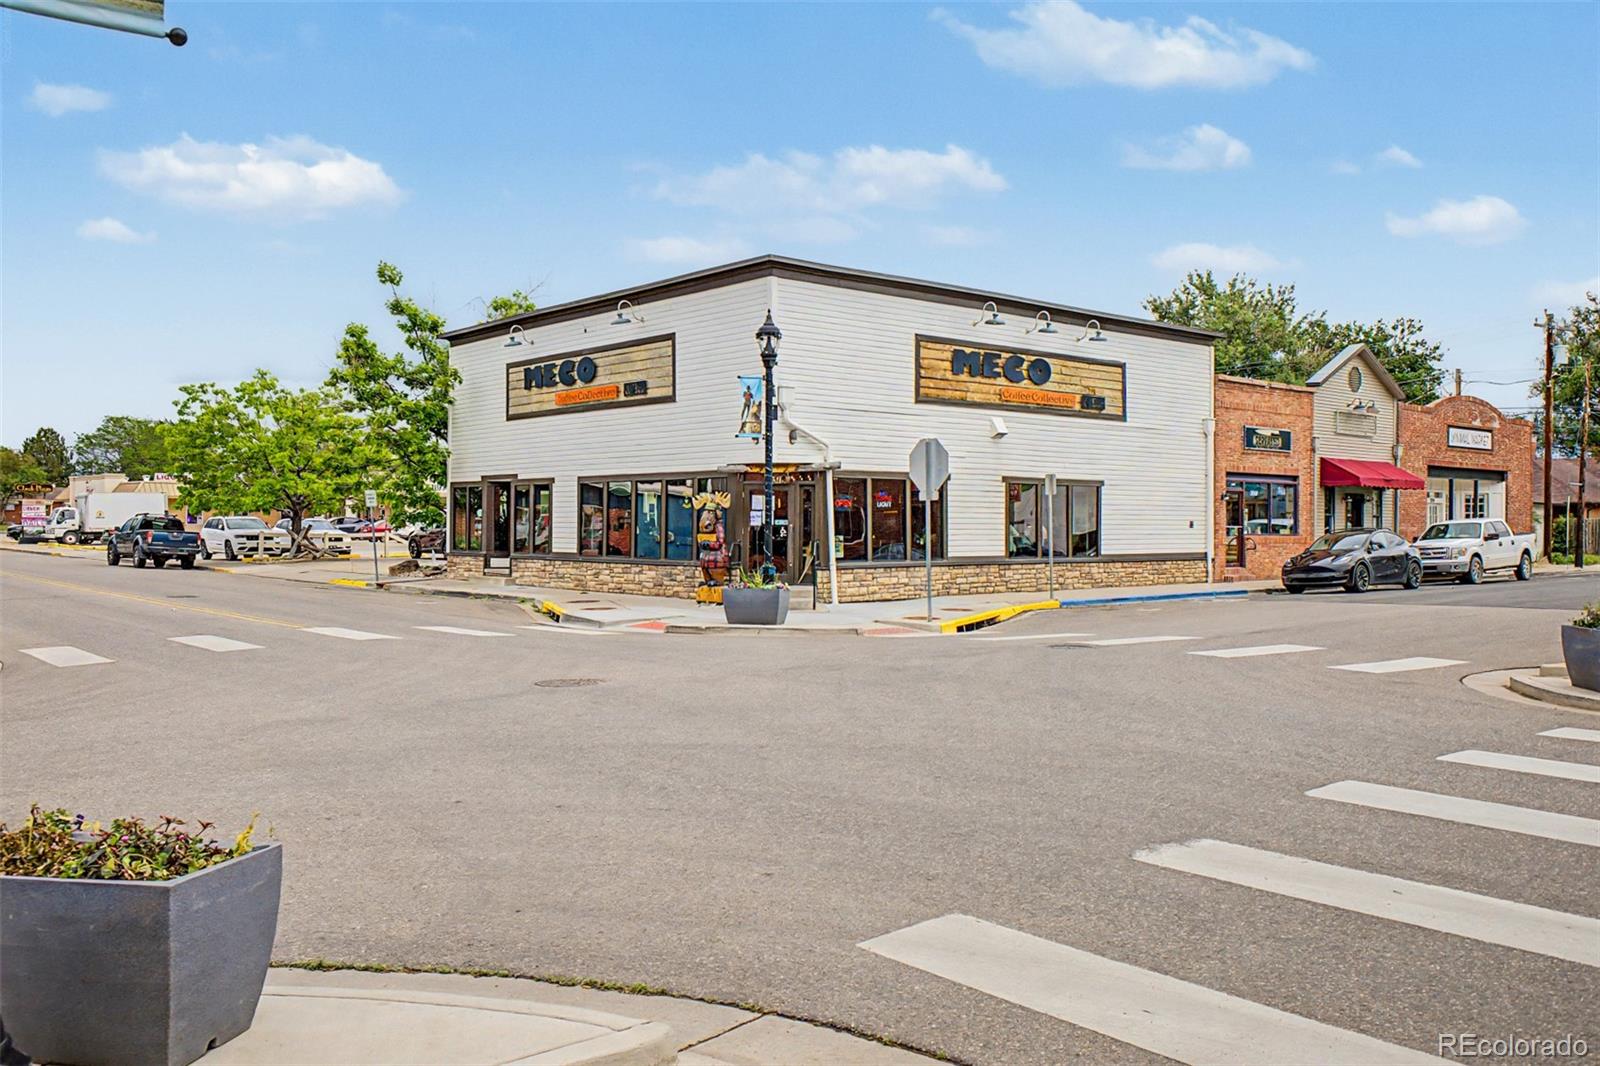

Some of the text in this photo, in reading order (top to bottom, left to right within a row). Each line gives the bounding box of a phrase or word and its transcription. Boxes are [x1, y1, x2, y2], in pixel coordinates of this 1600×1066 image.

[523, 356, 597, 391] MECO
[951, 348, 1052, 386] MECO
[1002, 389, 1031, 401] Coffee
[1032, 390, 1074, 405] Collective
